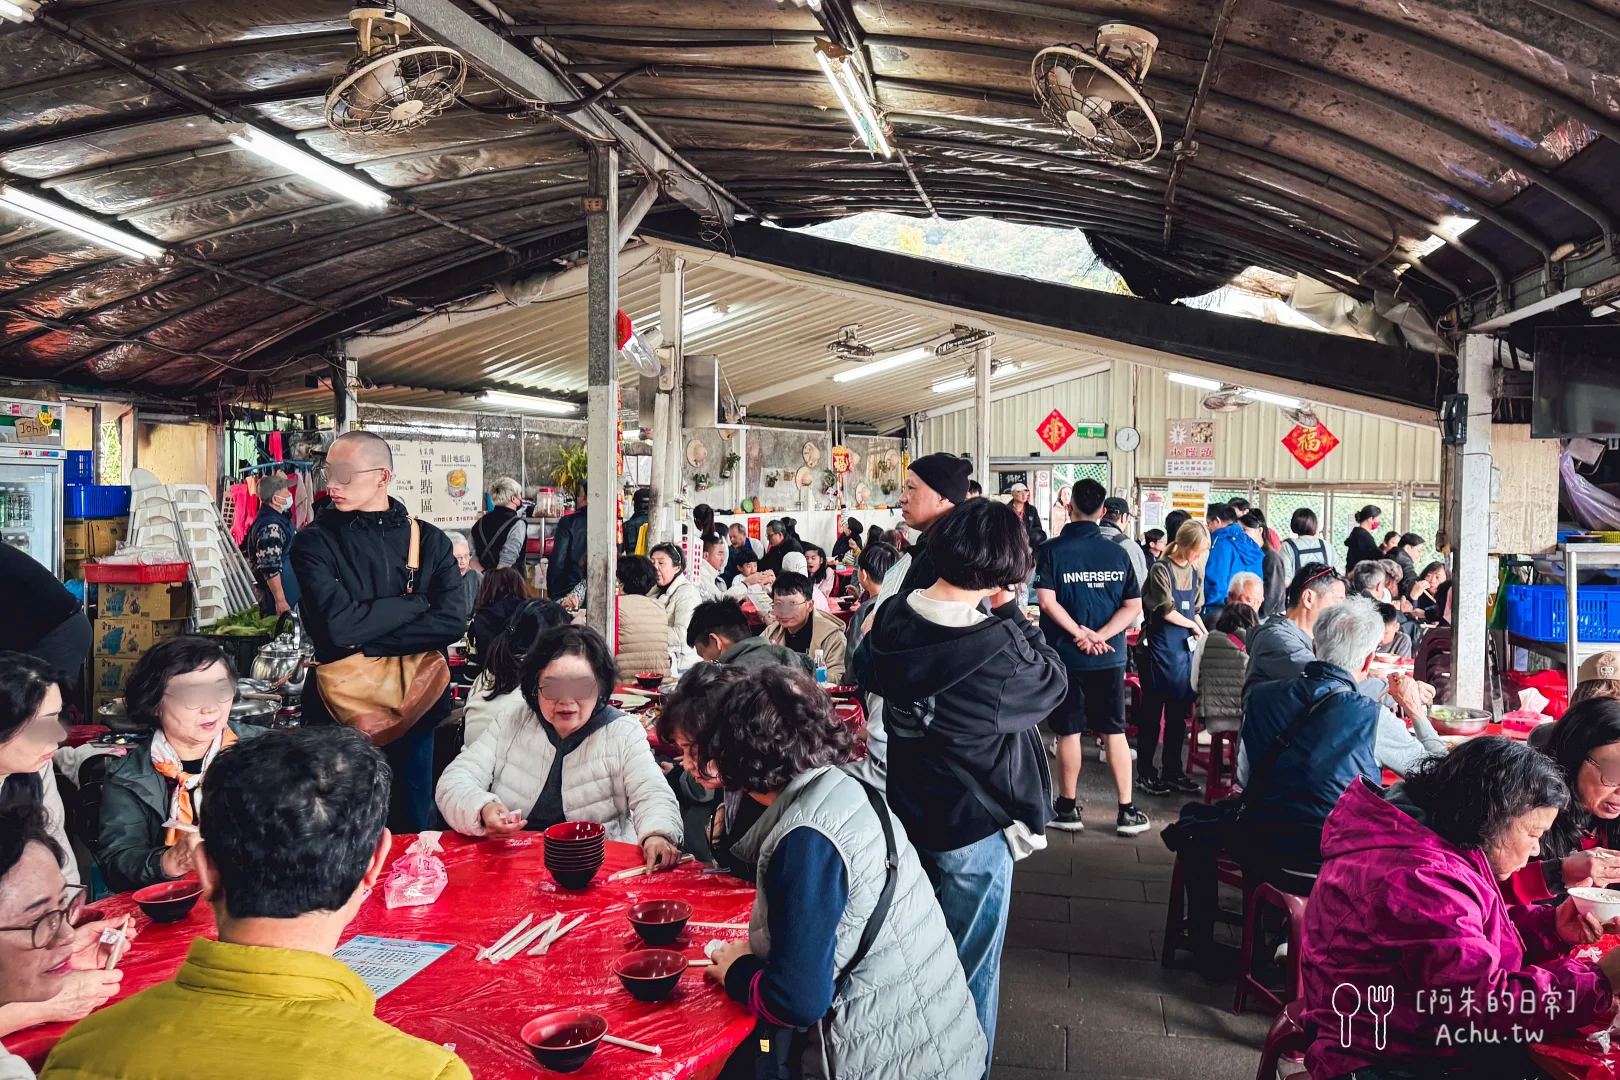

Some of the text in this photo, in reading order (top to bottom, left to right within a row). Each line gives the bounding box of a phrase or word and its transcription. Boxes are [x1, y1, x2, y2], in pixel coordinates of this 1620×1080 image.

[19, 421, 46, 434] John
[1297, 428, 1321, 452] 福
[1063, 571, 1125, 584] INNERSECT
